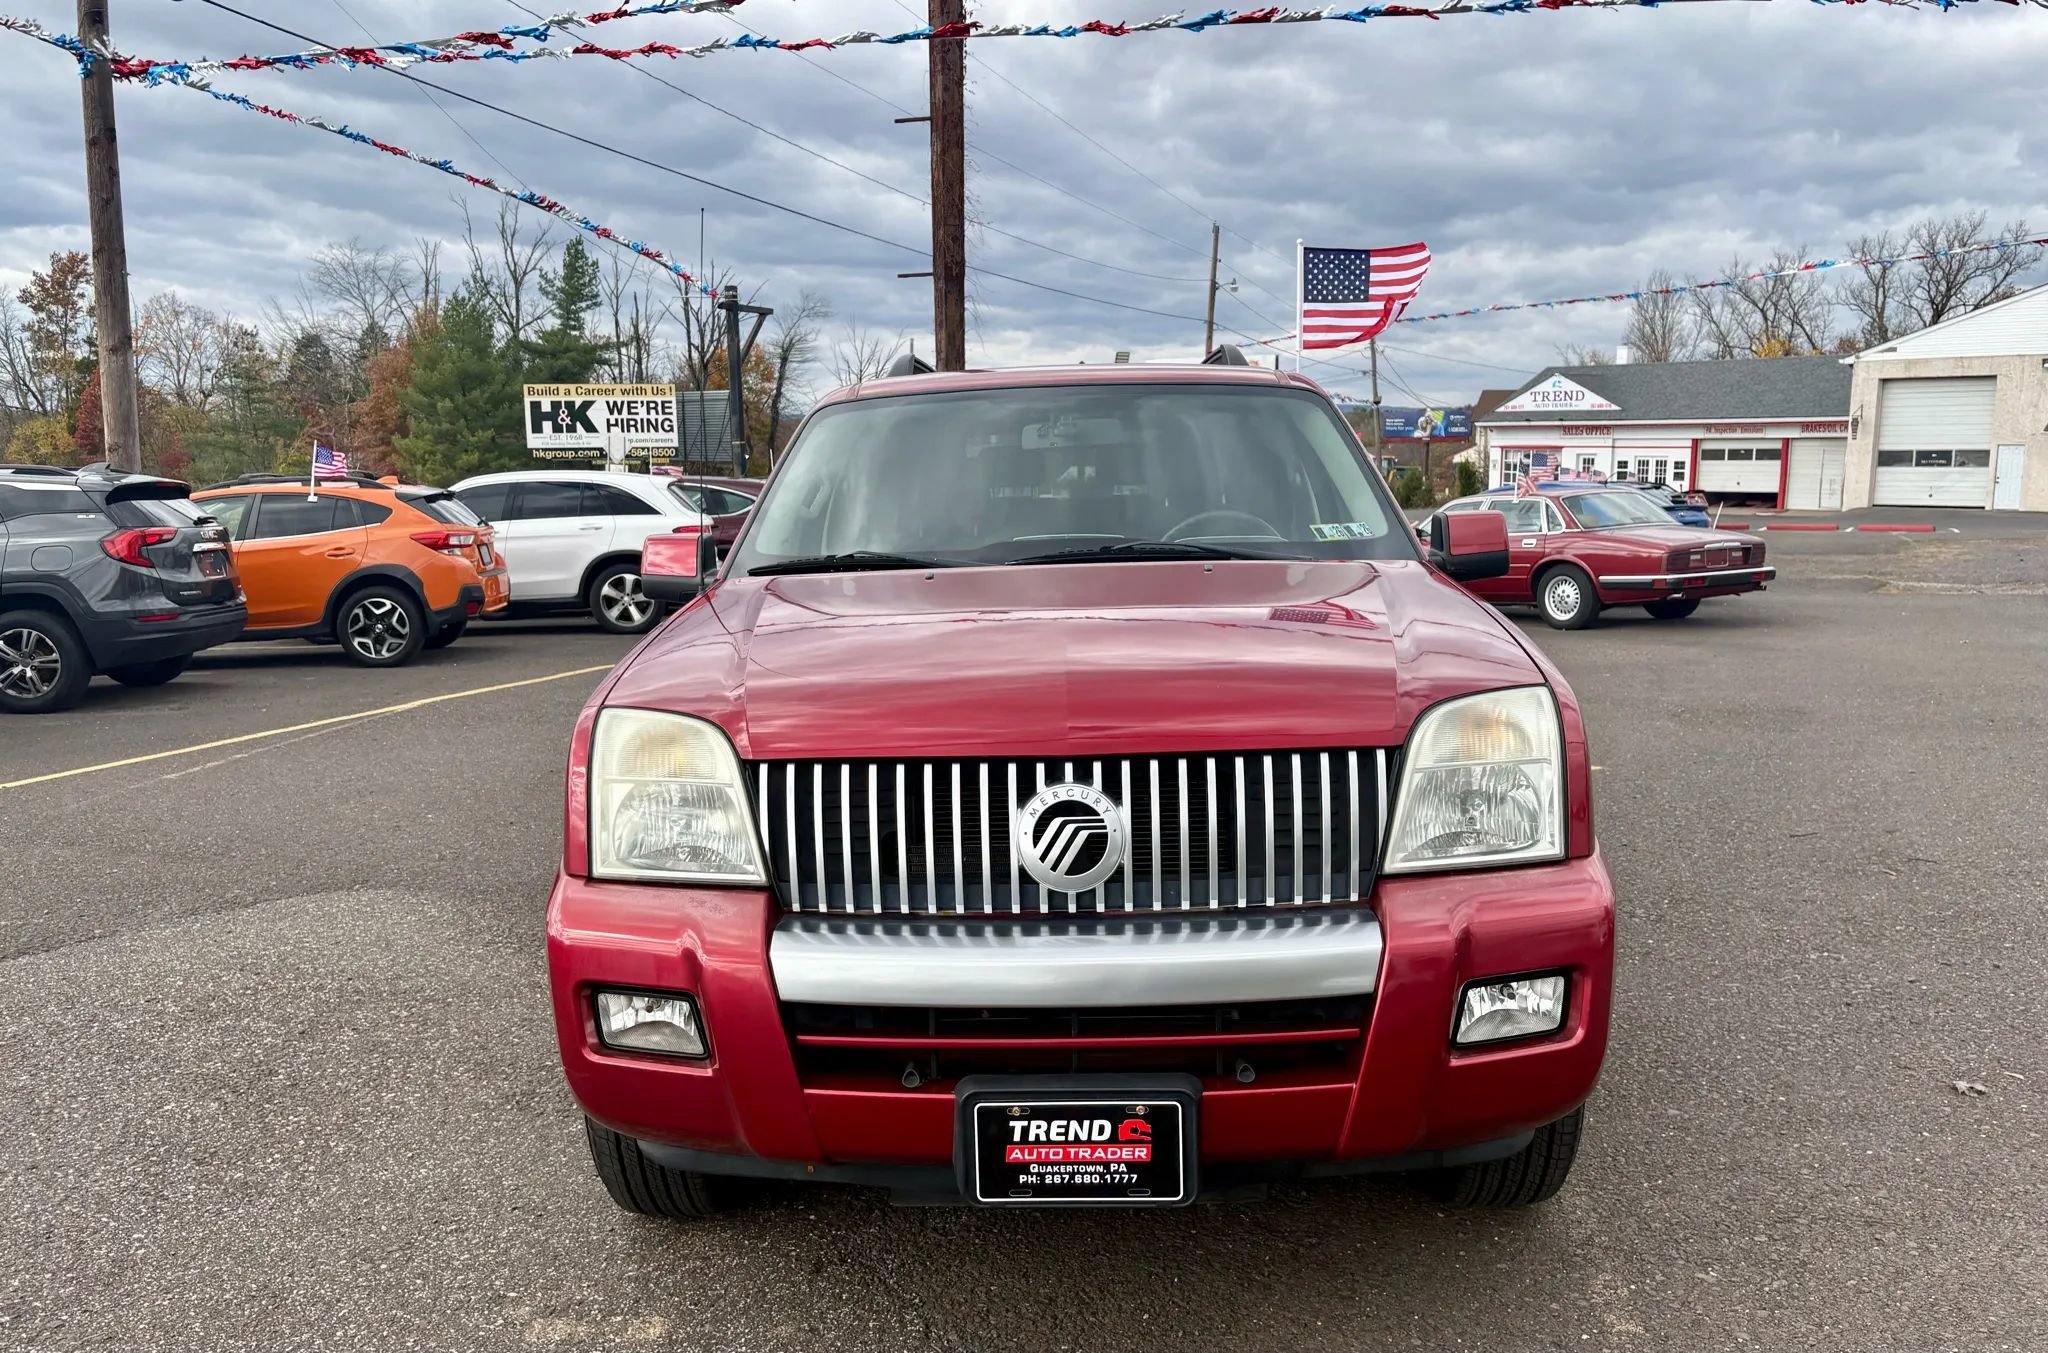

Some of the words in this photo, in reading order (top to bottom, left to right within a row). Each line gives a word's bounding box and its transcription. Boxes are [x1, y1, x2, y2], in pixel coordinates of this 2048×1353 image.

[527, 386, 560, 396] Build
[563, 387, 571, 396] a
[575, 386, 617, 396] Career
[618, 386, 647, 396] with
[1530, 390, 1585, 403] TREND
[605, 400, 674, 416] WE'RE
[529, 400, 600, 434] H&K
[606, 418, 675, 433] HIRING
[1585, 426, 1612, 436] OFFICE
[532, 449, 600, 459] hkgroup.com
[1029, 788, 1111, 818] MERCURY
[1008, 1119, 1112, 1142] TREND
[1009, 1148, 1063, 1160] AUTO
[1067, 1147, 1148, 1159] TRADER
[1110, 1163, 1128, 1173] PA
[1019, 1174, 1041, 1184] PH:
[1045, 1174, 1138, 1184] 267.680.1777
